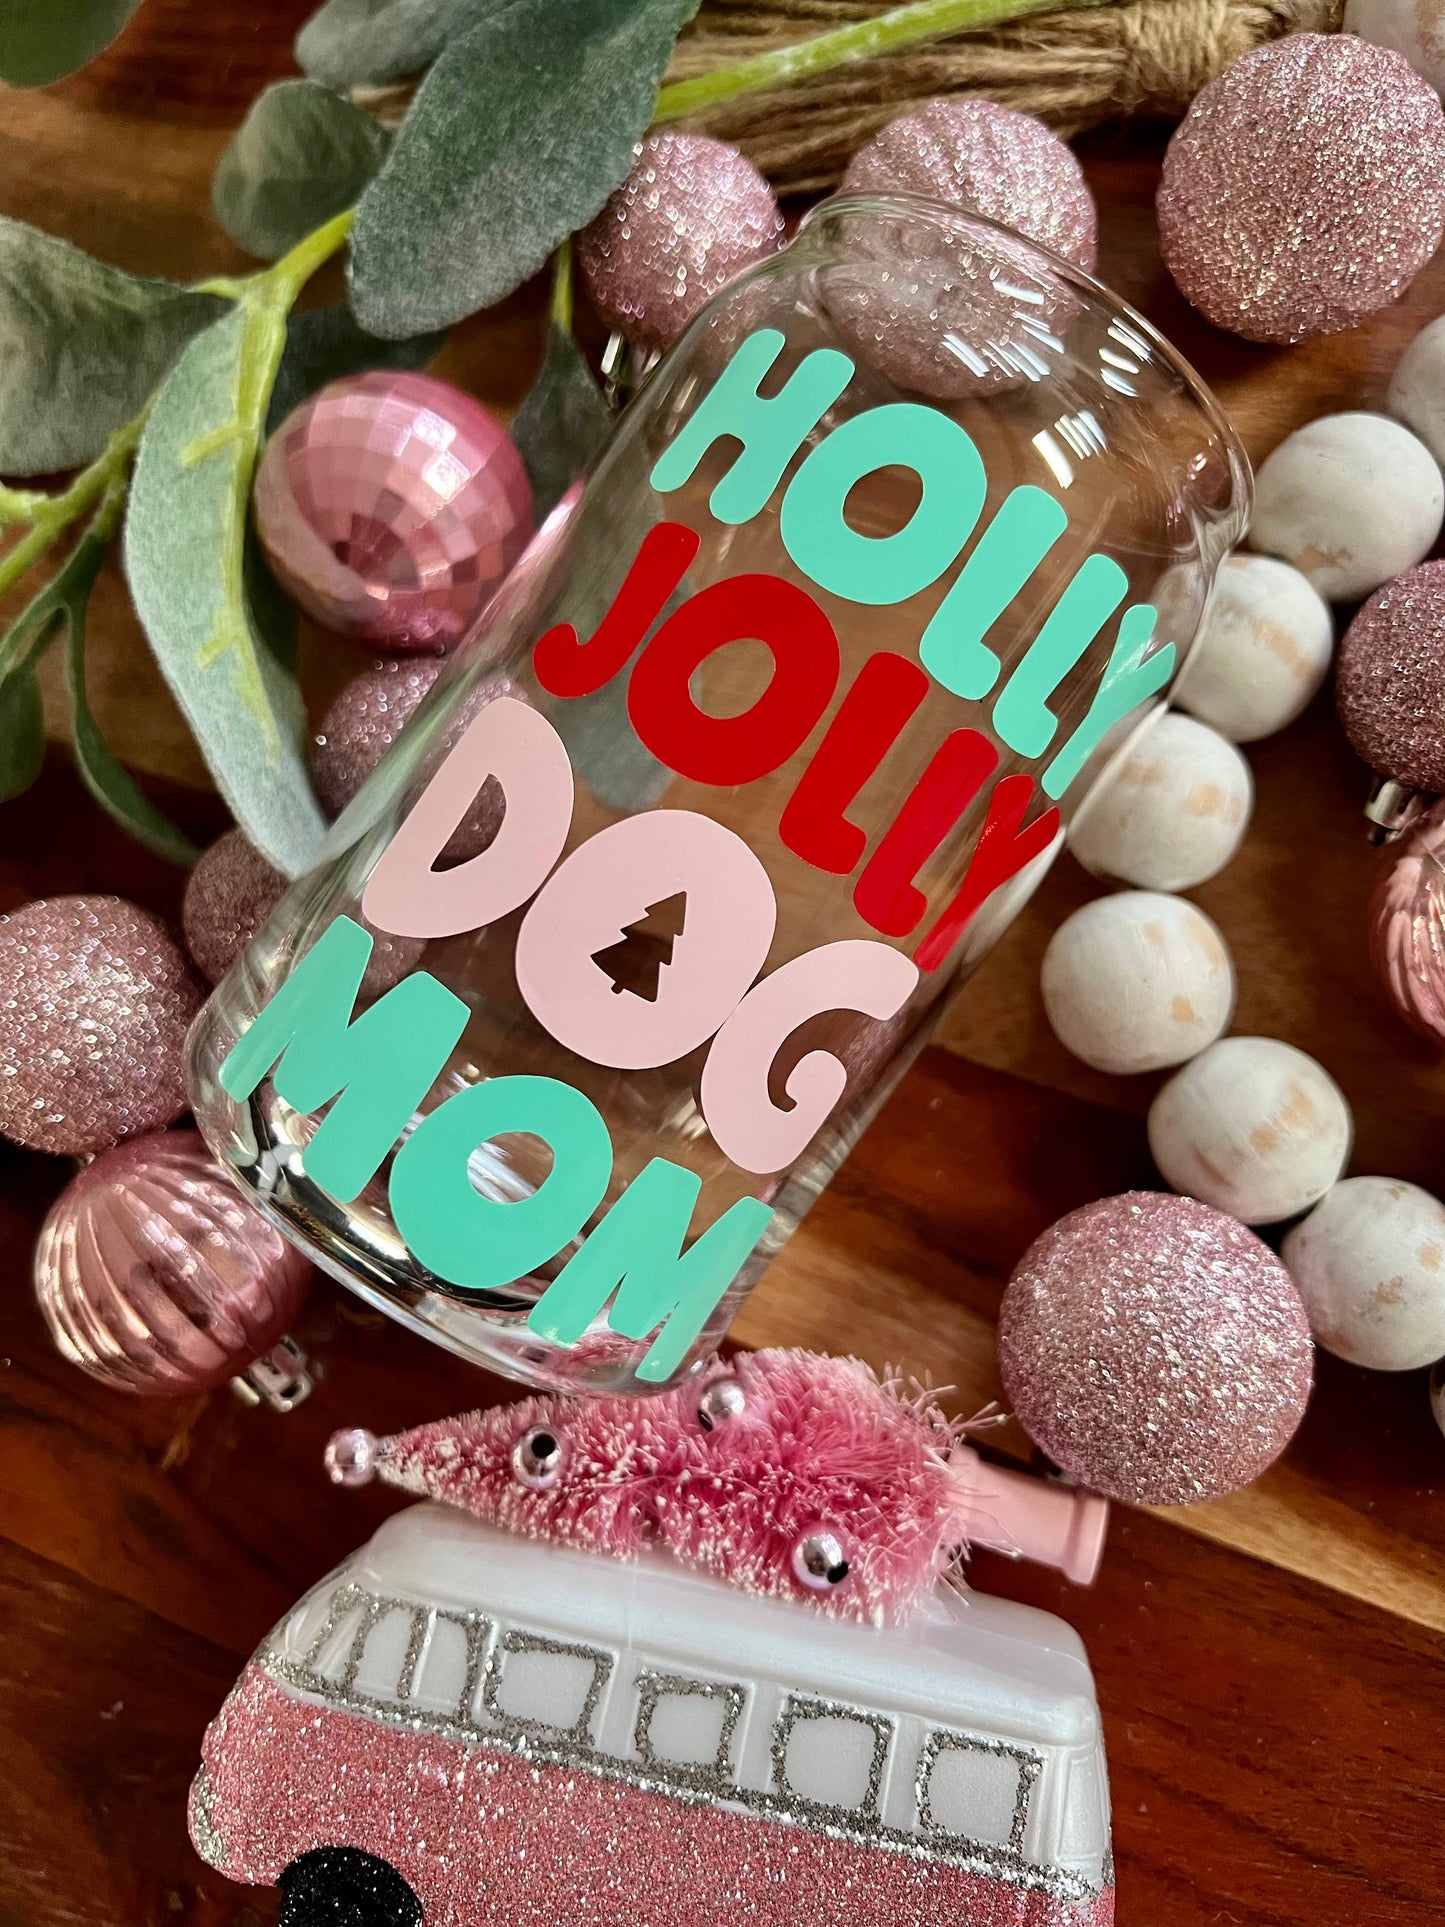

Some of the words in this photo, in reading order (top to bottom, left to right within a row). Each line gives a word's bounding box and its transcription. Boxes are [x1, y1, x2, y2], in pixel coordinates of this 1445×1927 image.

[533, 522, 1061, 973] JOLLY
[650, 328, 1176, 800] HOLLY
[218, 915, 775, 1382] MOM
[361, 696, 920, 1175] DOG
